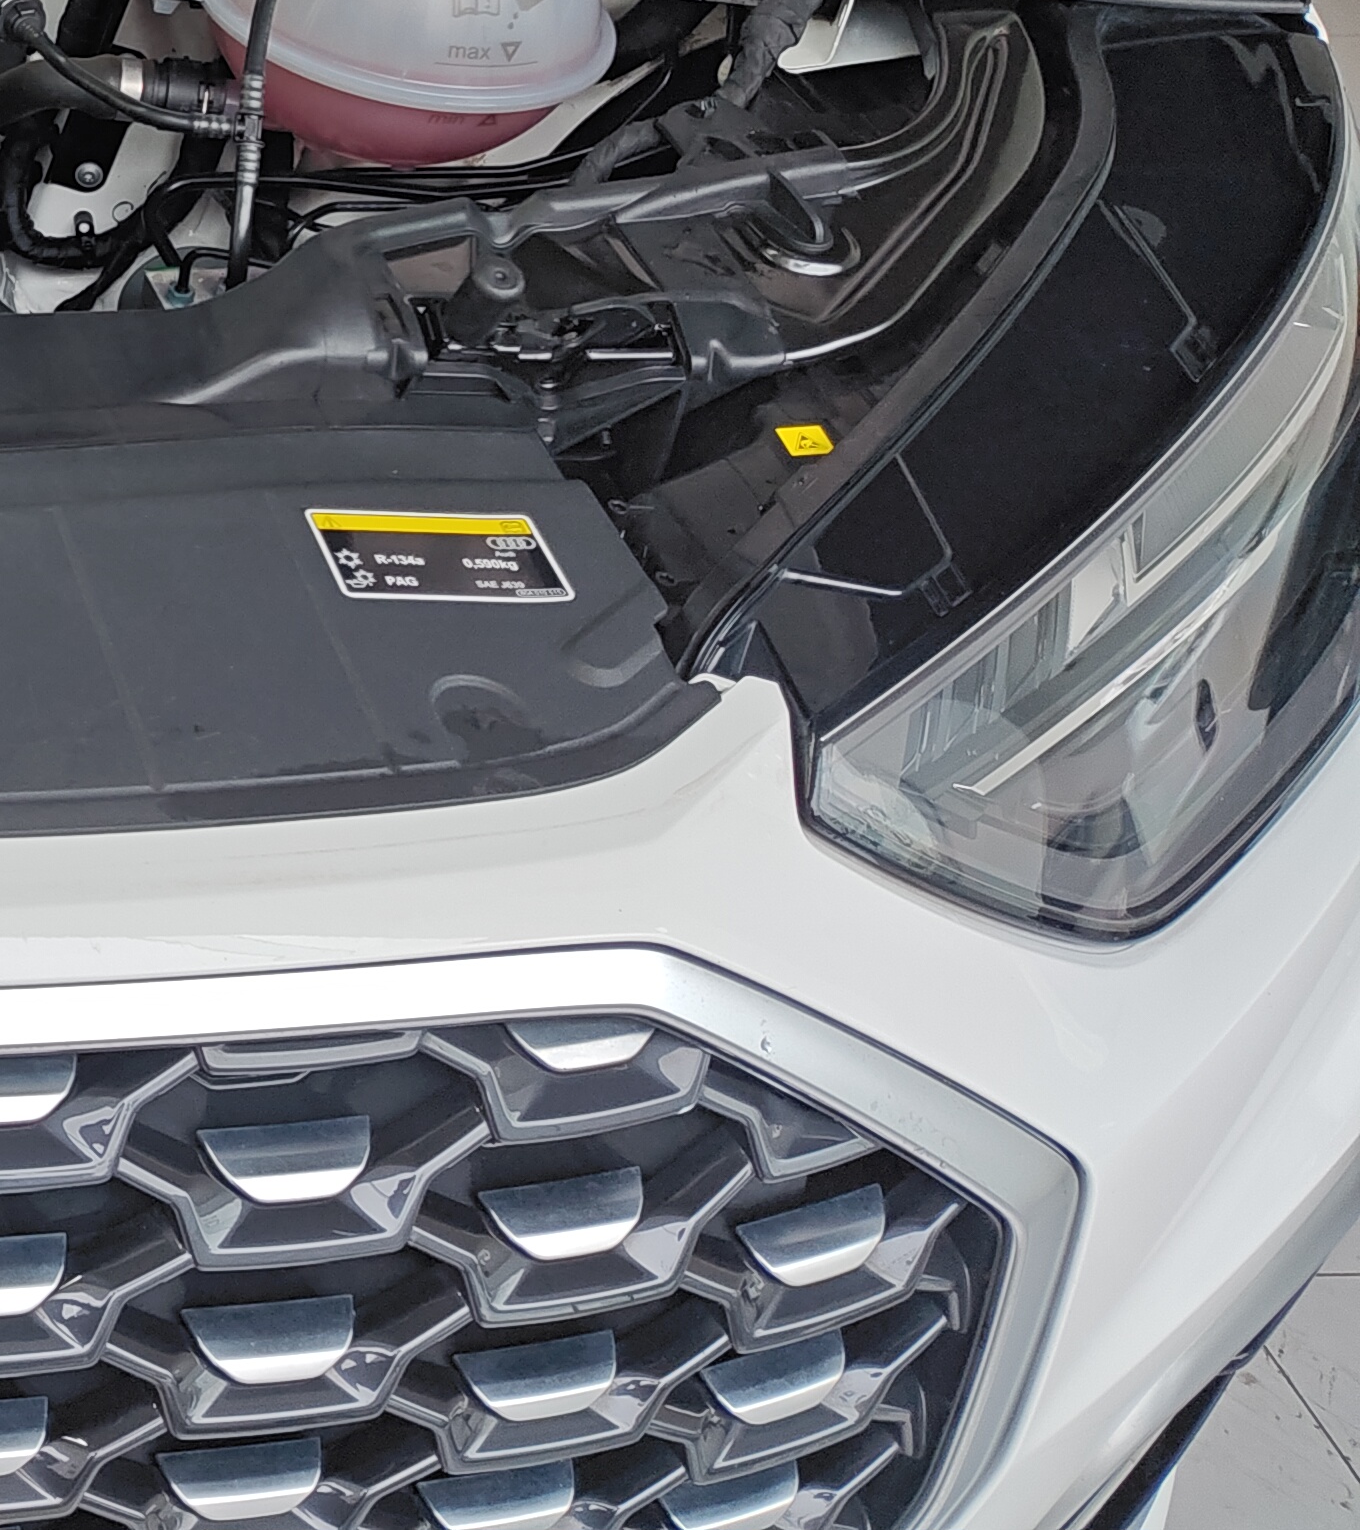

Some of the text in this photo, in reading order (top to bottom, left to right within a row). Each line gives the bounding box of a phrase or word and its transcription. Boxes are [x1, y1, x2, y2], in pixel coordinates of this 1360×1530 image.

[447, 44, 491, 60] max
[428, 114, 465, 125] min
[373, 553, 425, 566] R-134a
[384, 574, 419, 587] PAG
